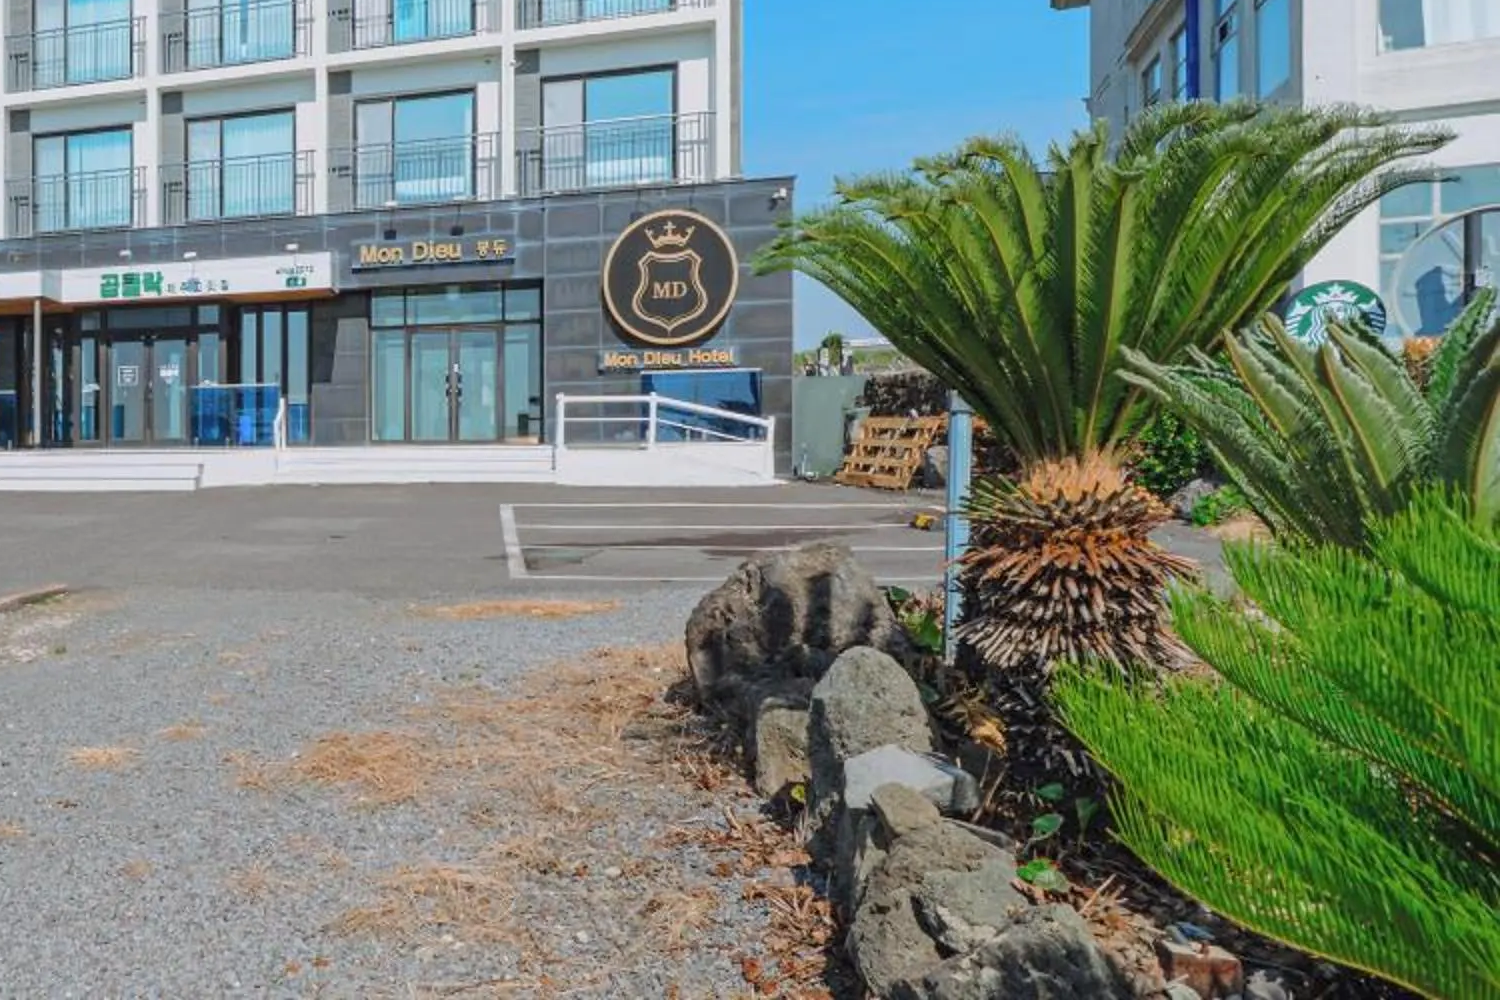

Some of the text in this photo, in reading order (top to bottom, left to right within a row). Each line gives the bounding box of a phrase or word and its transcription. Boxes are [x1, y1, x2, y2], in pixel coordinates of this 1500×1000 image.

[360, 244, 404, 265] Mon
[411, 239, 463, 263] Dieu
[652, 280, 688, 299] MD
[604, 348, 733, 367] Mon Dieu Hotel
